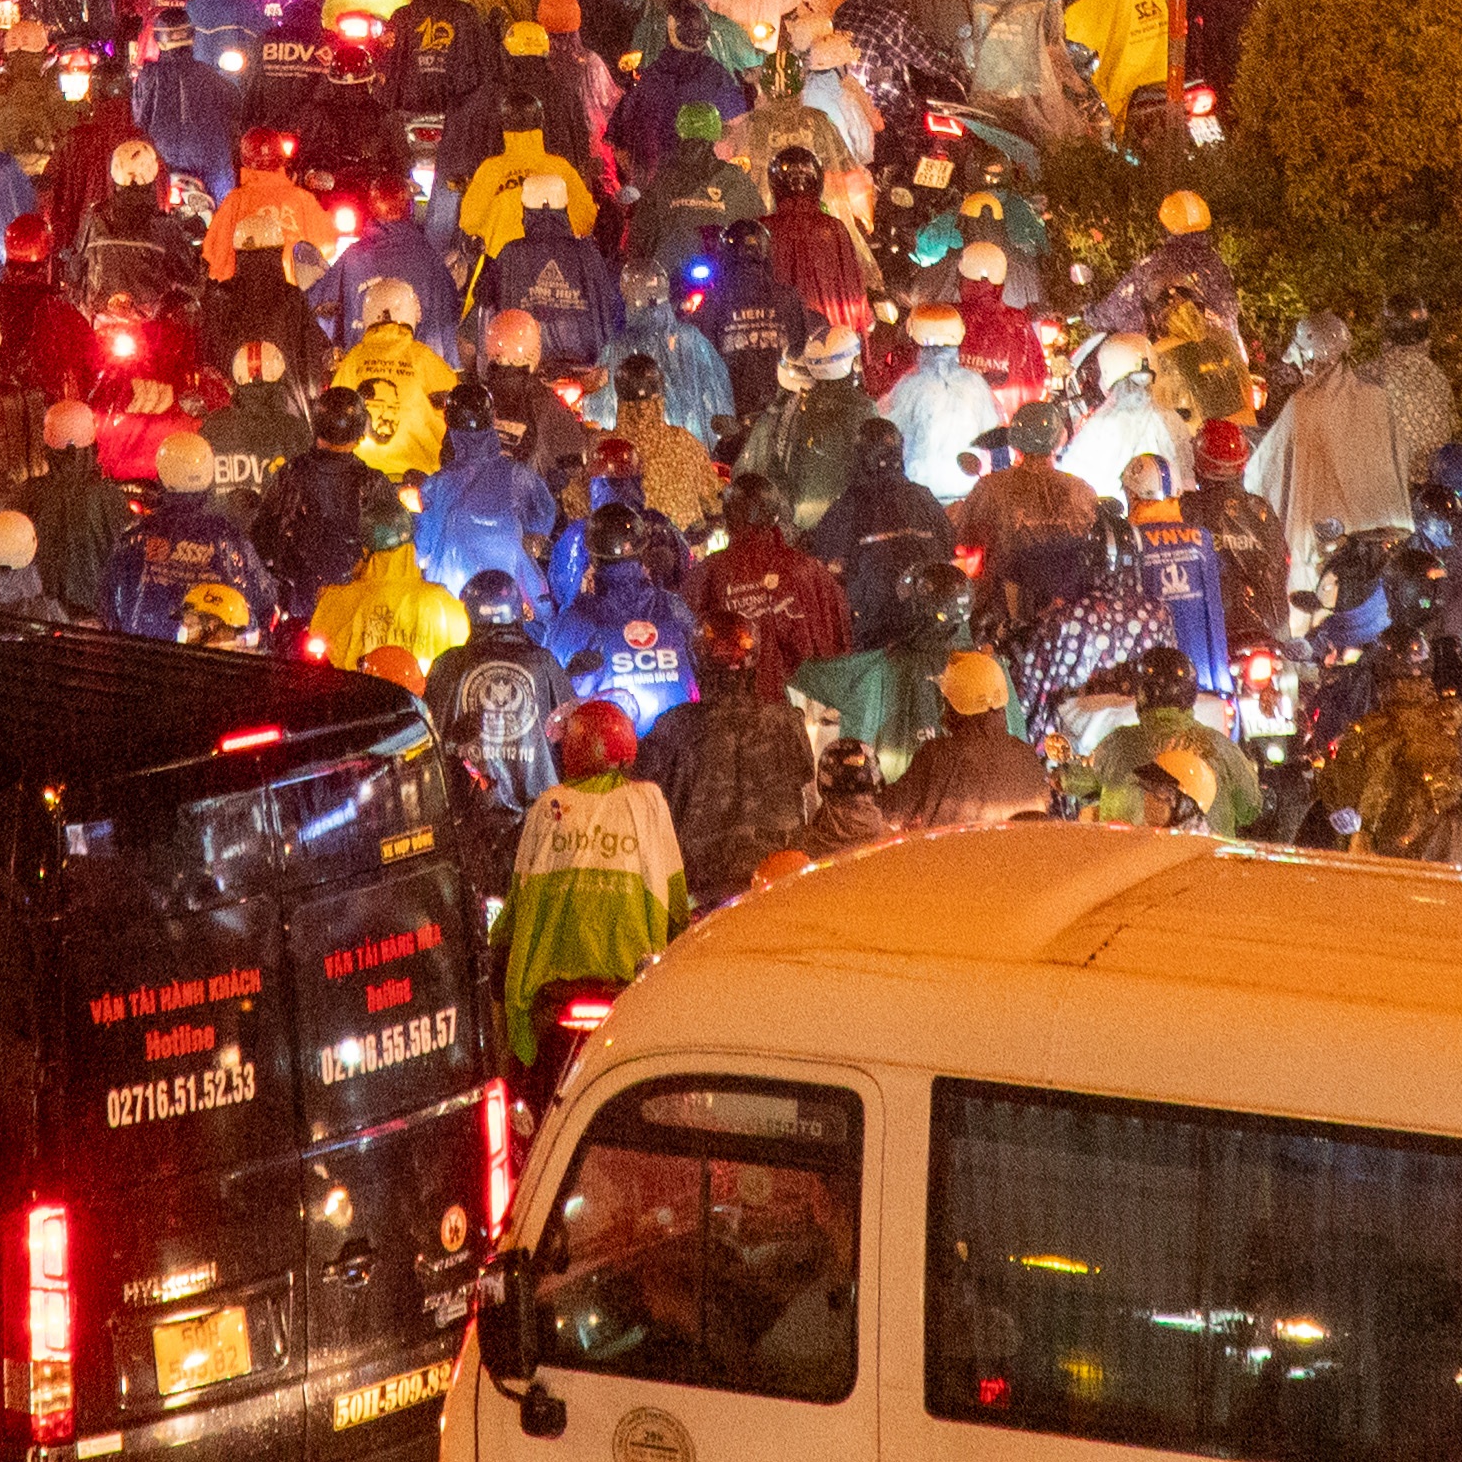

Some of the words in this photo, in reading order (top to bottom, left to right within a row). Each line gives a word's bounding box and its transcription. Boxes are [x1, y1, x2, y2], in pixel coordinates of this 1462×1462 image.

[263, 43, 315, 62] BIDV
[214, 454, 271, 484] BIDV
[1145, 529, 1203, 547] VNVC
[611, 649, 679, 673] SCB
[356, 937, 379, 971] TẢI
[89, 992, 125, 1029] VẬN
[129, 984, 156, 1017] TẢI
[160, 978, 205, 1012] HÀNH
[208, 969, 261, 1005] KHÁCH
[145, 1025, 216, 1061] Hotline
[107, 1063, 255, 1128] 02716.51.52.53
[336, 1362, 452, 1427] 50H-509.82
